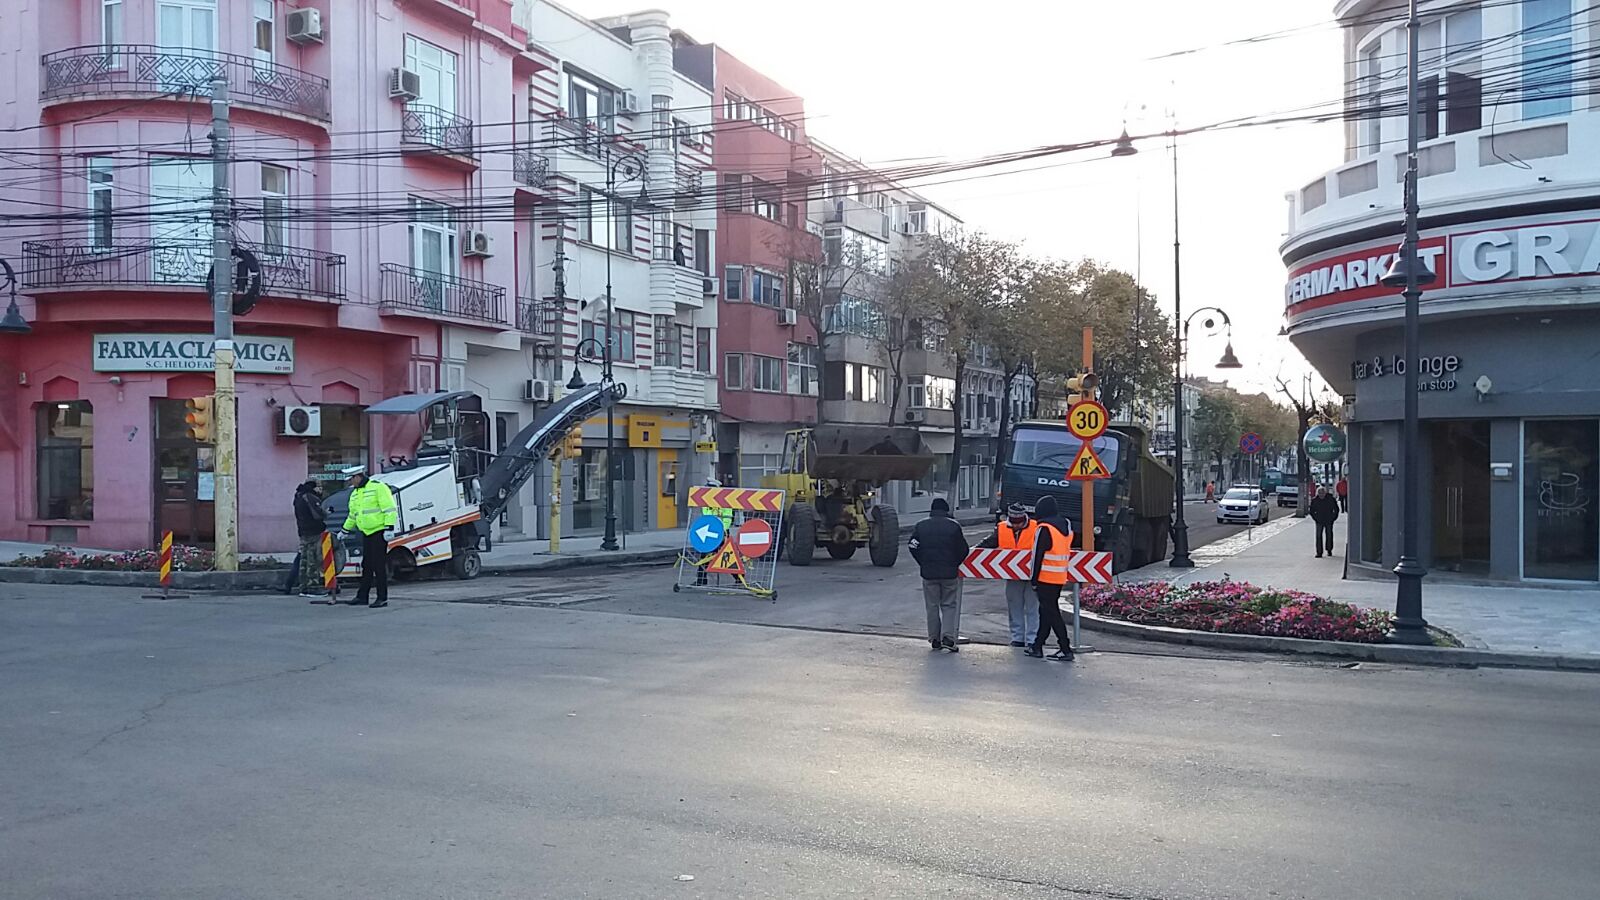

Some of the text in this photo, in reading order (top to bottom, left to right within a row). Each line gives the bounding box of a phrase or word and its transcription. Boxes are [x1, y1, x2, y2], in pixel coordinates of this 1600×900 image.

[1288, 246, 1444, 304] PERMARKT
[165, 360, 216, 369] HELIOFAR
[1373, 356, 1383, 377] &
[1392, 355, 1458, 378] longe
[1430, 378, 1455, 392] stop
[1076, 411, 1099, 430] 30
[1038, 478, 1070, 487] DAC
